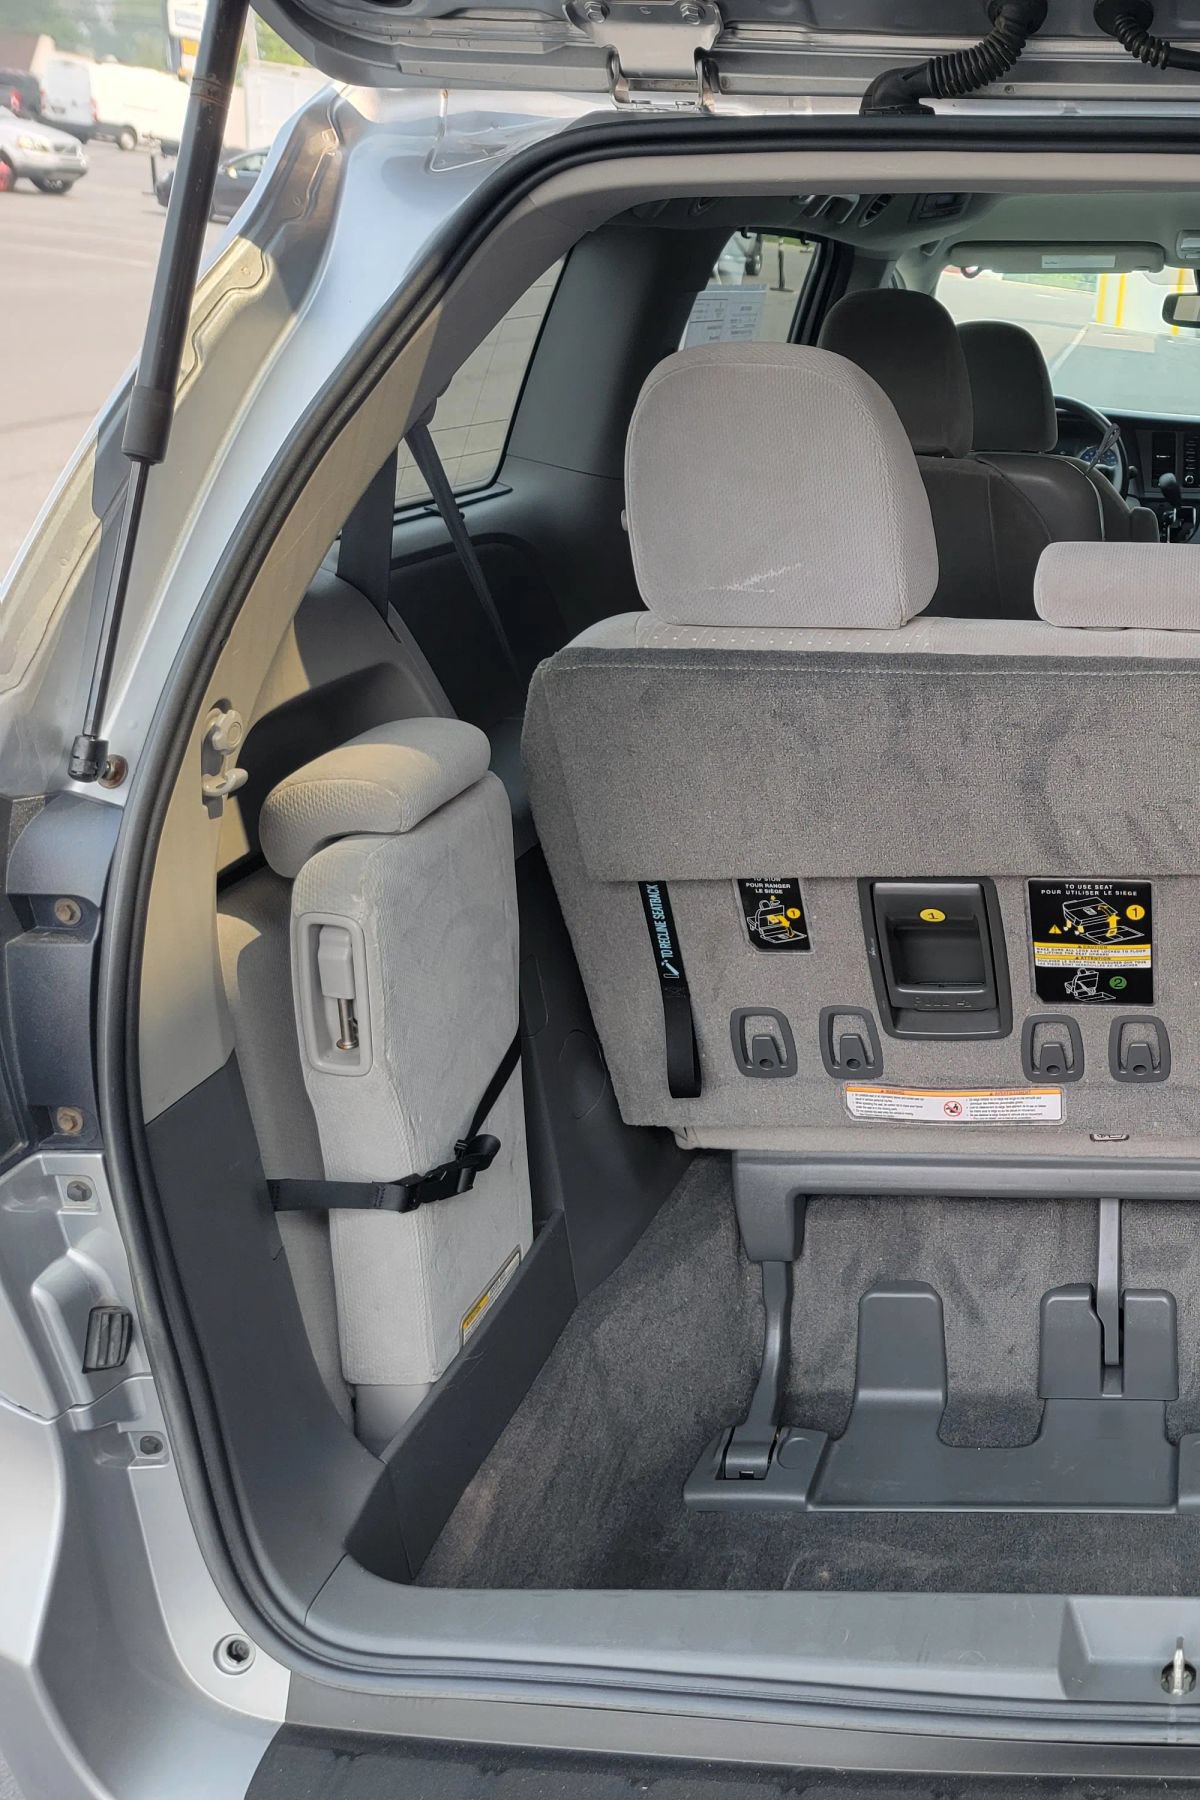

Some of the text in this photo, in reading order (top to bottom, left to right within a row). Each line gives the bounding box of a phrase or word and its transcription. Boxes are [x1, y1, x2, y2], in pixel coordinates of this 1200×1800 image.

[646, 883, 674, 959] TO RECLINE SEATBACK
